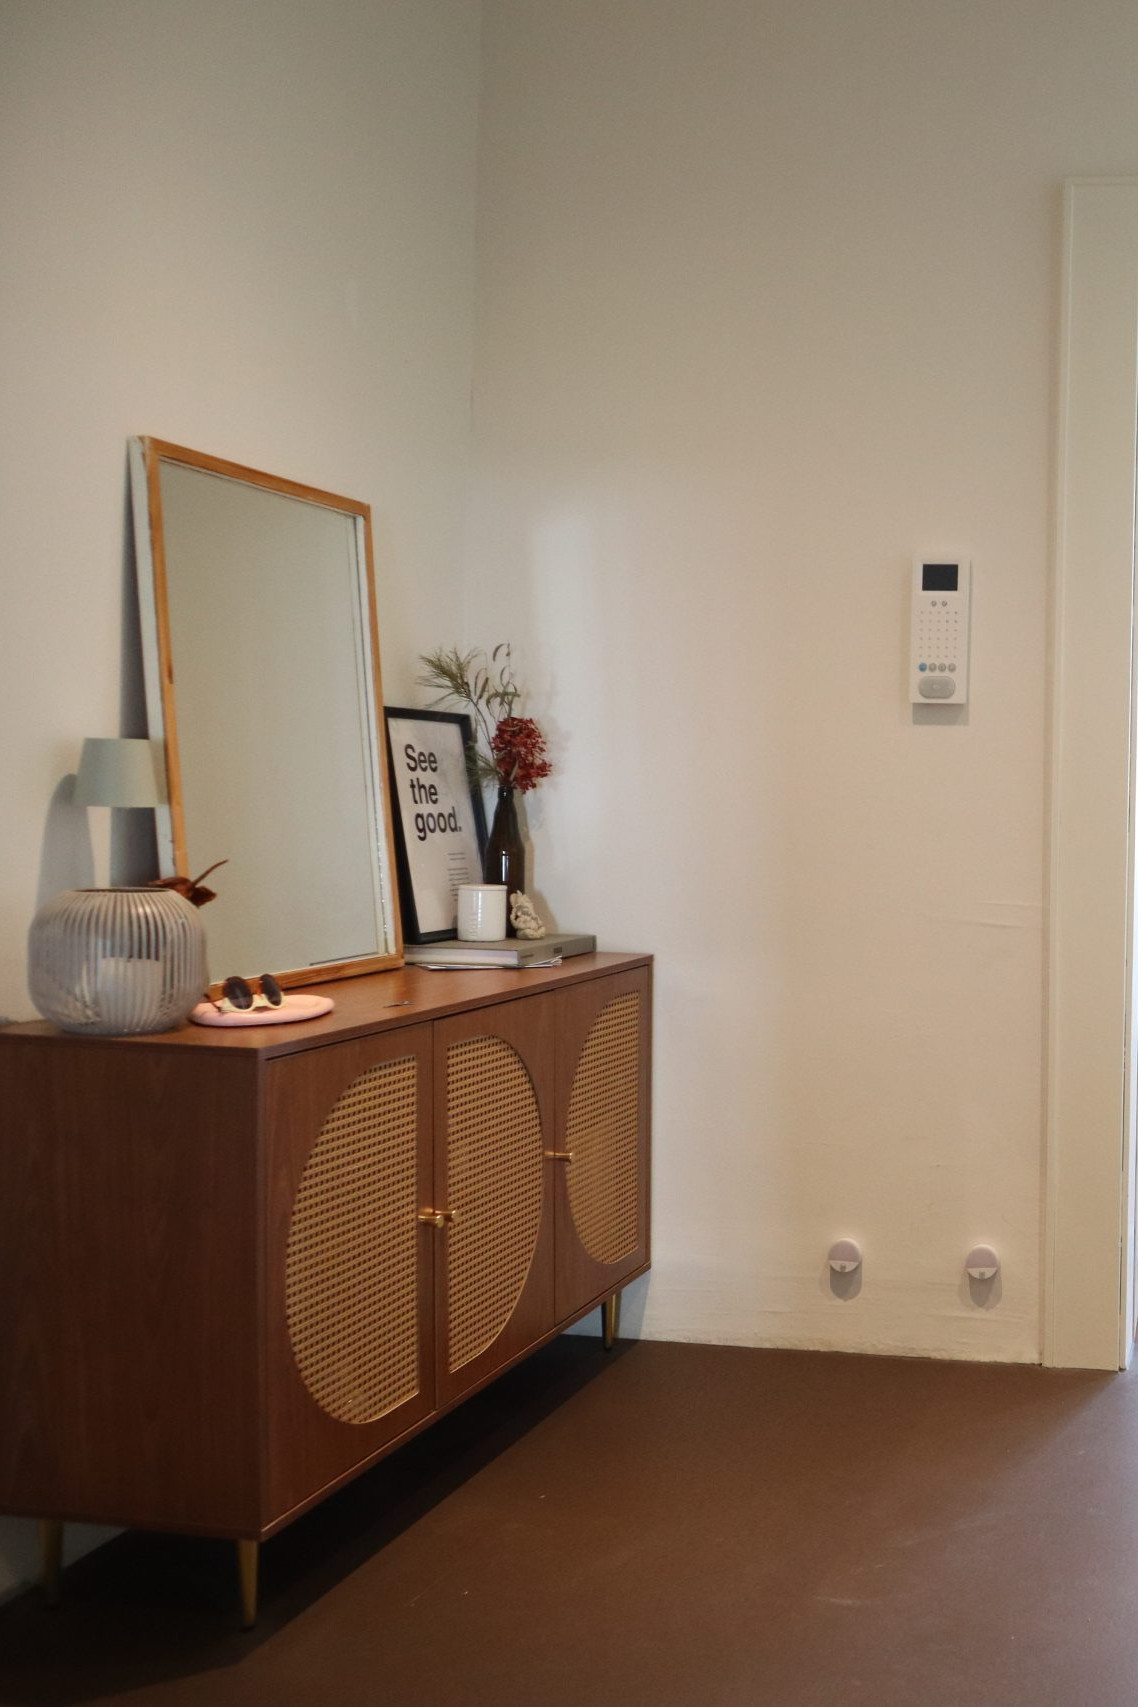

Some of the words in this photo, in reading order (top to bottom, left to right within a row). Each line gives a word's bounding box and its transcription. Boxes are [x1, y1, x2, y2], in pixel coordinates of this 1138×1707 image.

[404, 744, 438, 772] See
[410, 777, 439, 805] the
[415, 806, 462, 841] good.
